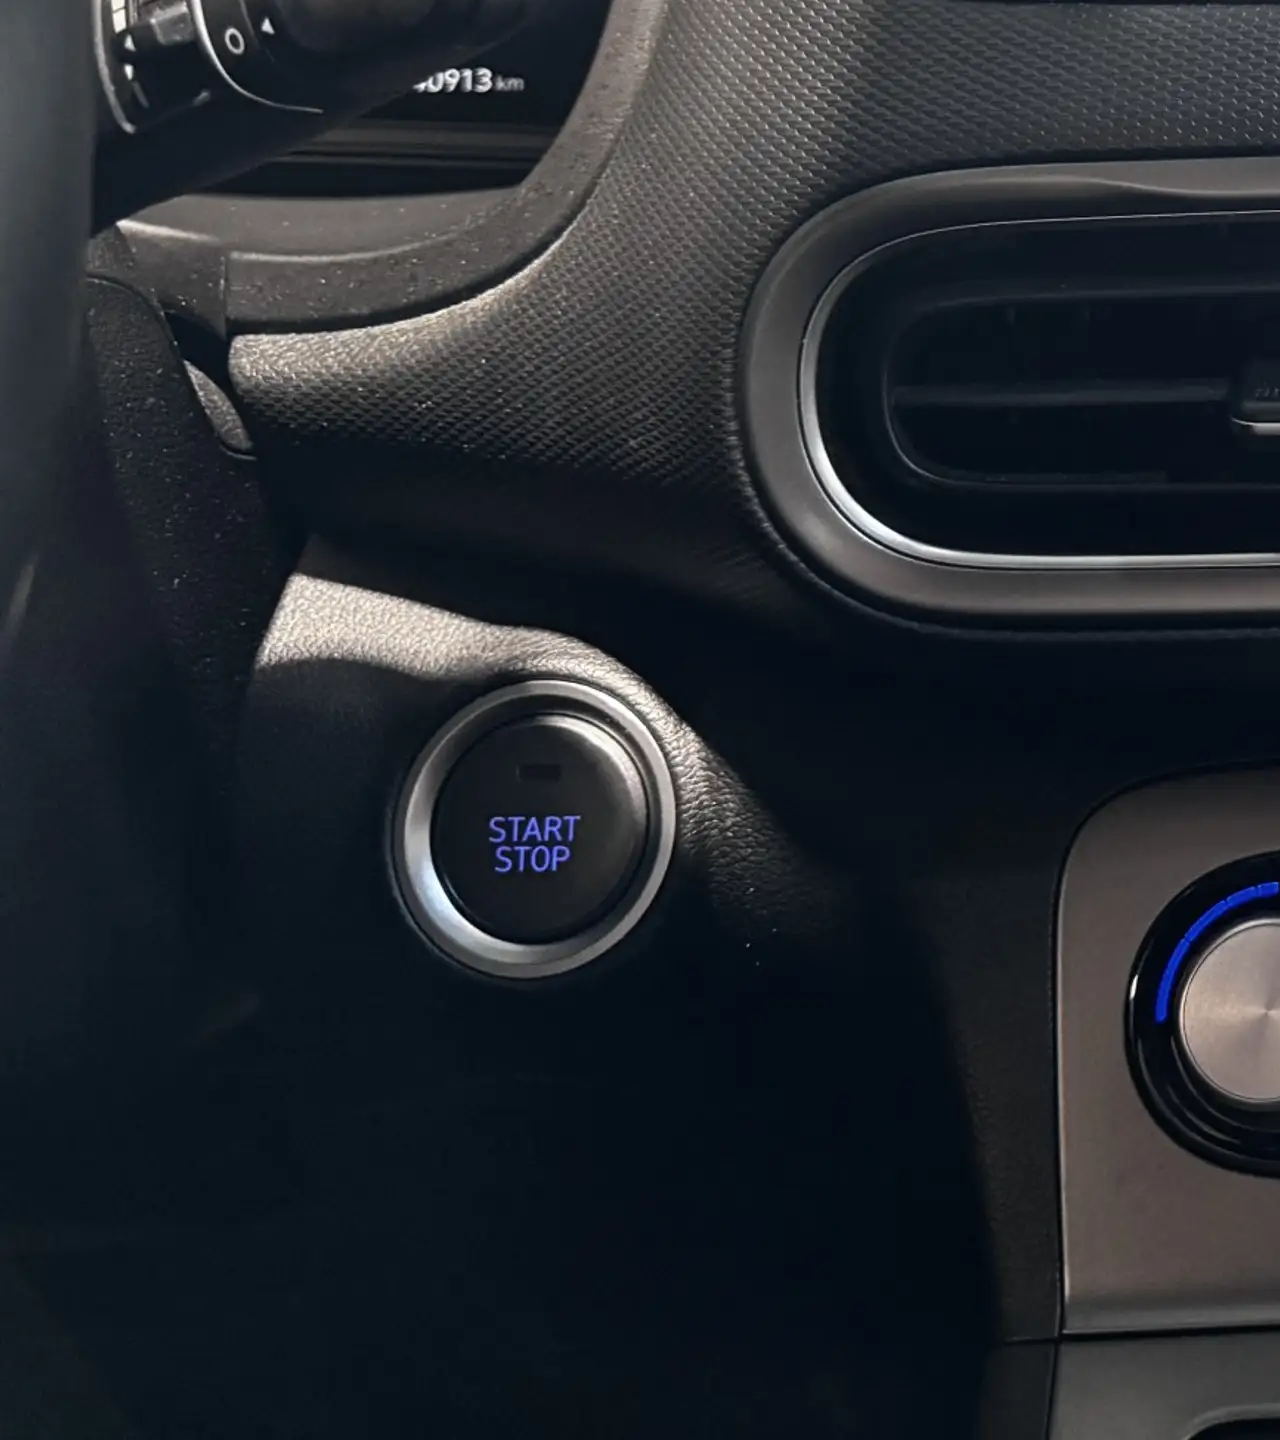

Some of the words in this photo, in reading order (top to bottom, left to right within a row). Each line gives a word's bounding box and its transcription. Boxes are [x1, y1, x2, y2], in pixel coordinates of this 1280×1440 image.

[496, 74, 525, 93] km
[489, 815, 582, 844] START
[494, 845, 572, 874] STOP
